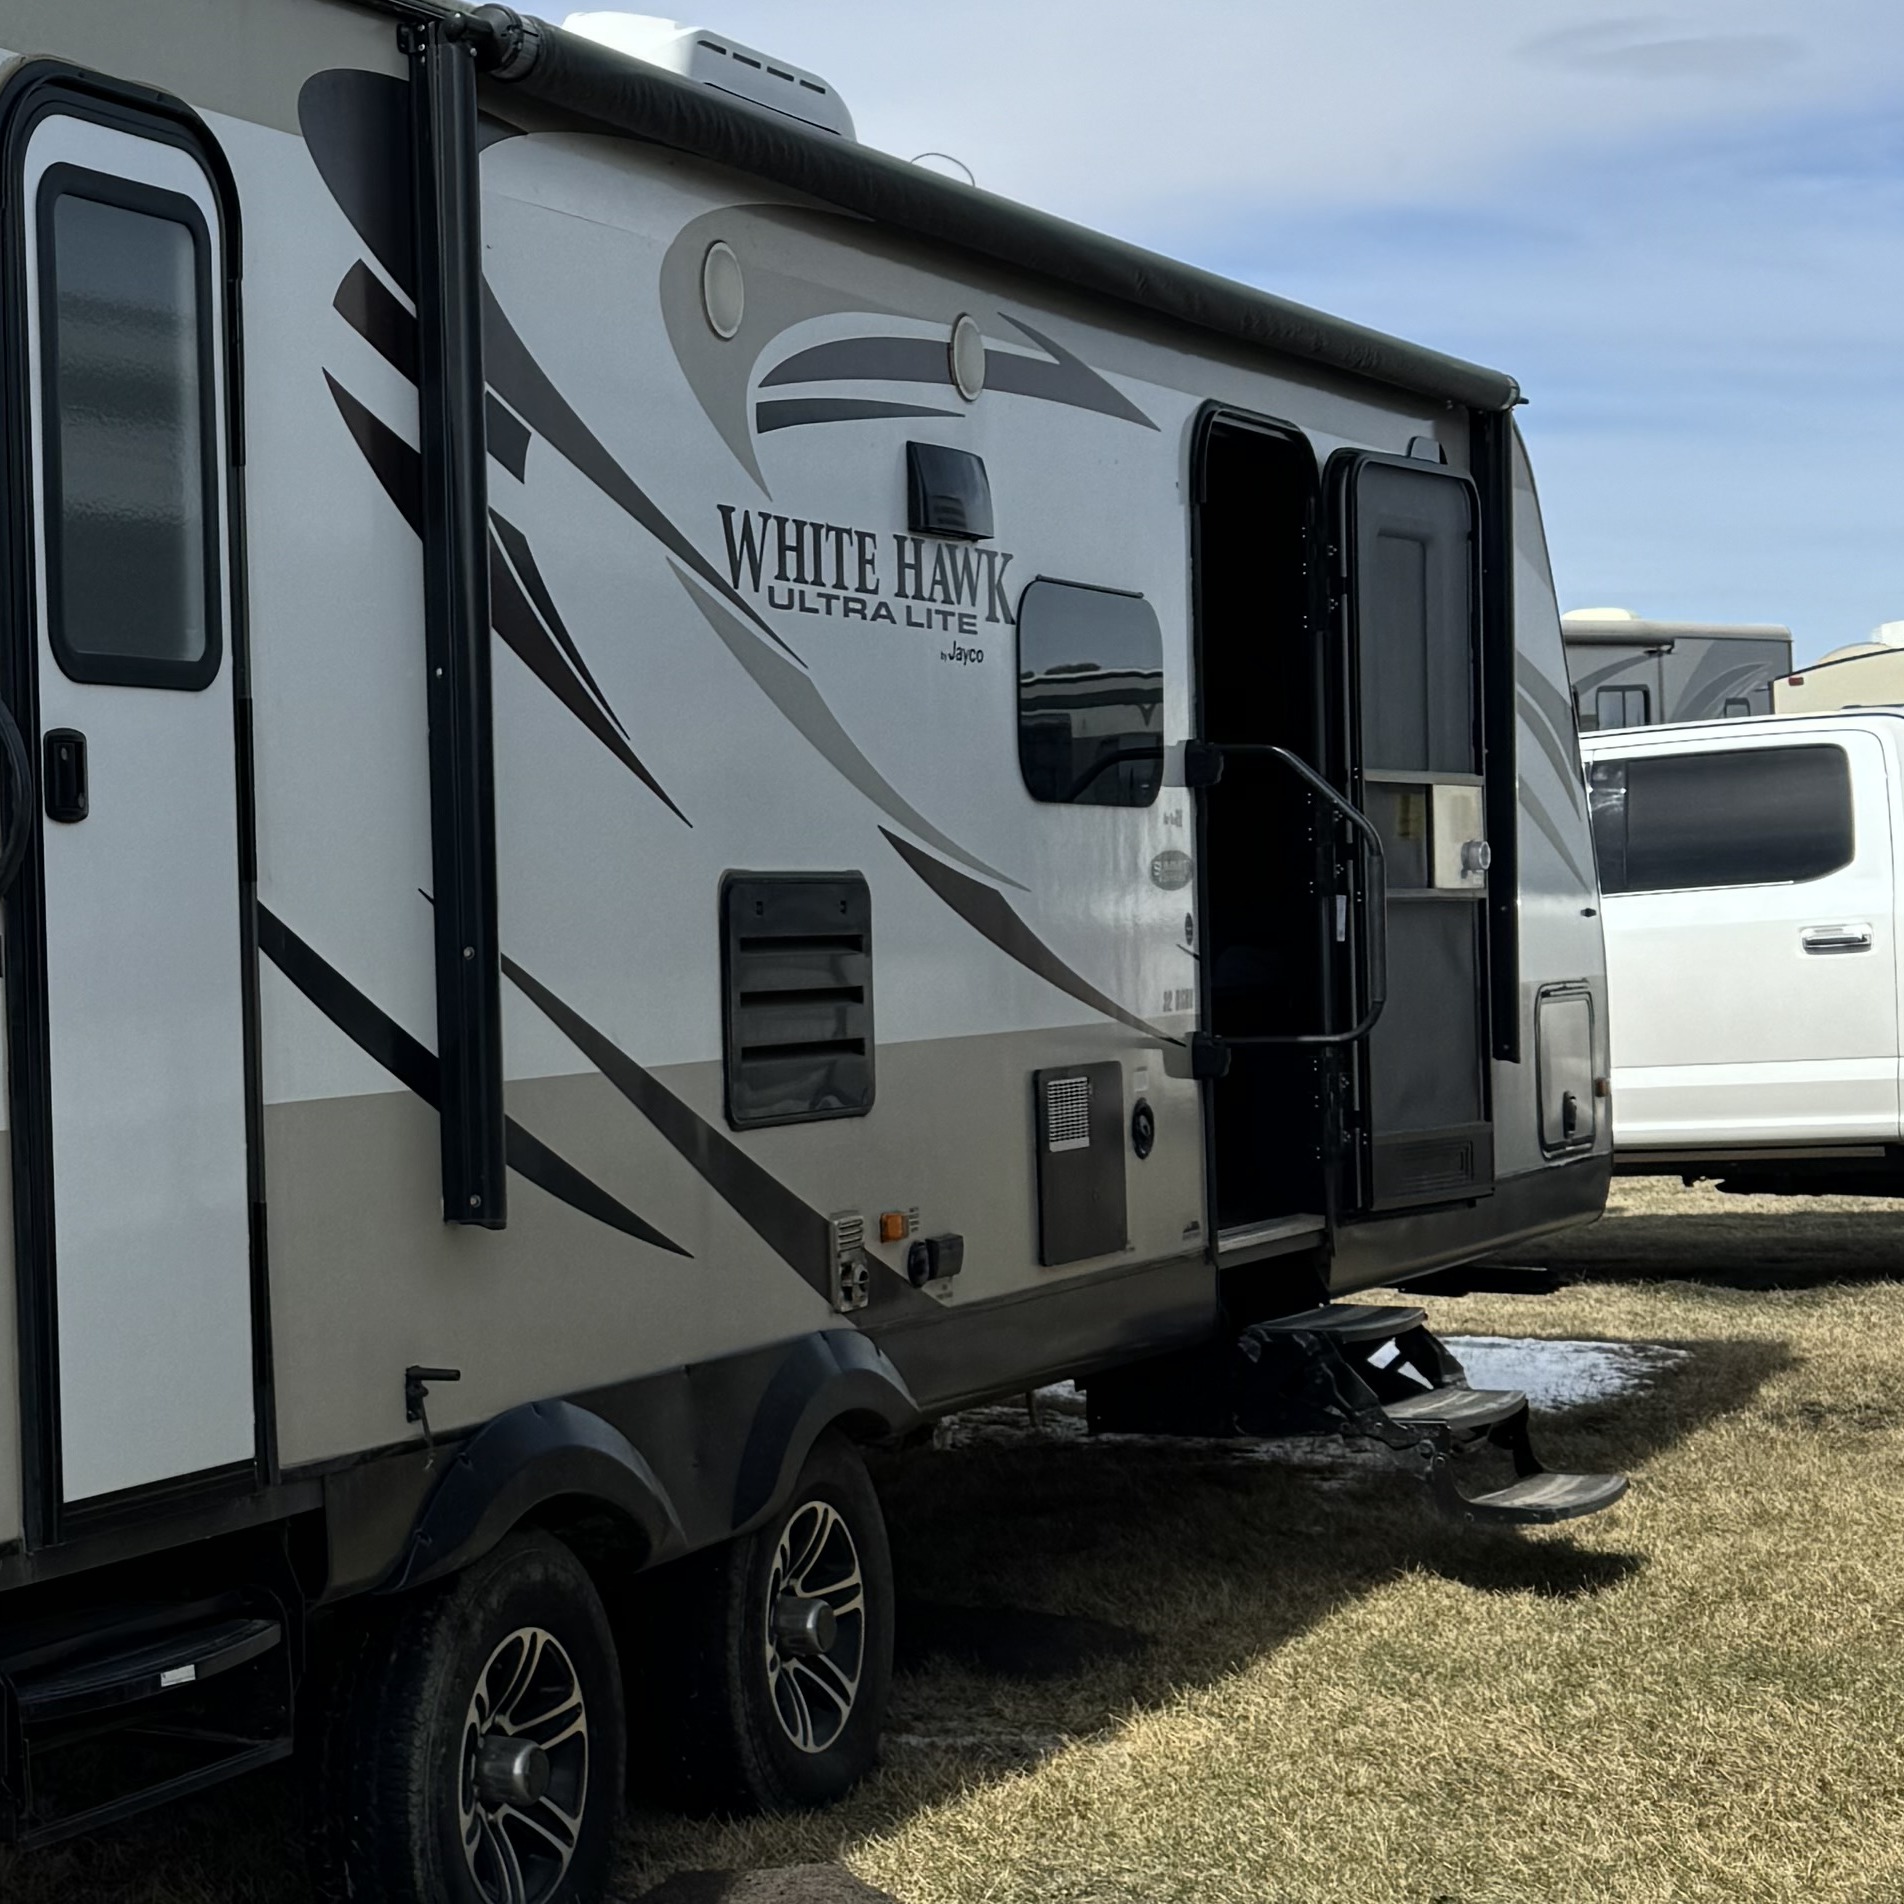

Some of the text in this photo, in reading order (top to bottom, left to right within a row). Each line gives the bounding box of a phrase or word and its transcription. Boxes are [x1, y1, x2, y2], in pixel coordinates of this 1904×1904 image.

[716, 503, 1017, 626] WHITE HAWK
[767, 585, 979, 636] ULTRA LITE
[948, 640, 984, 666] Jayco
